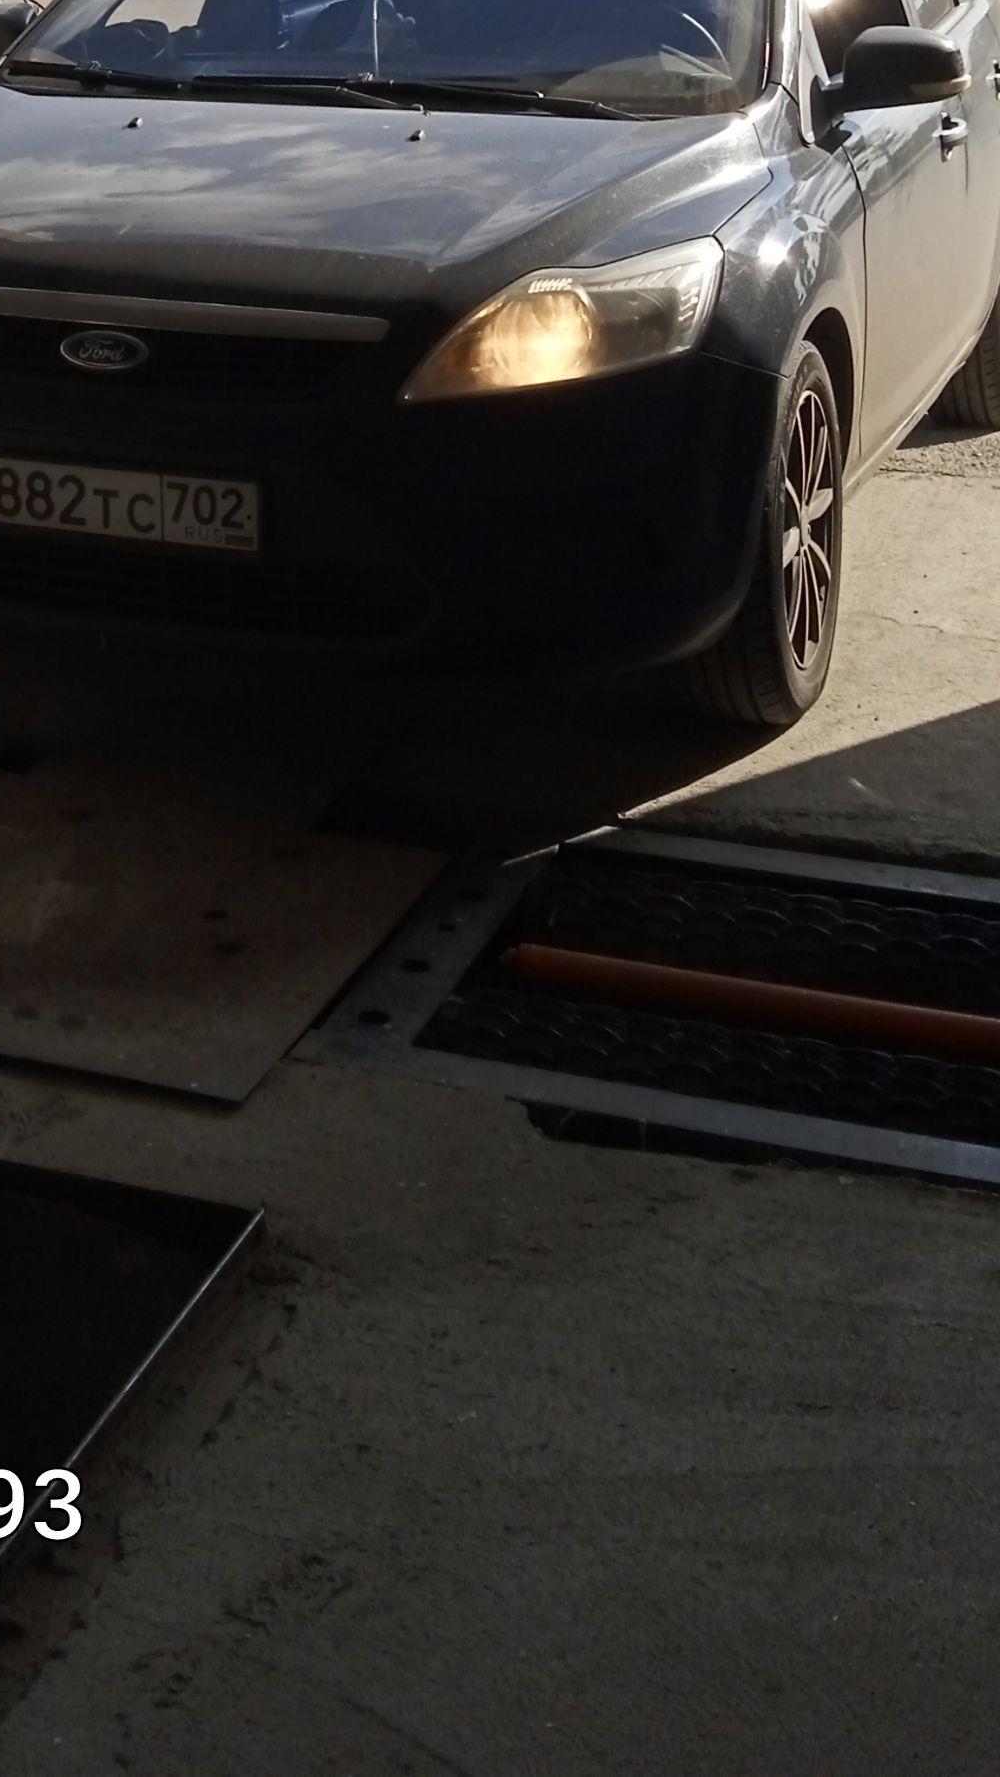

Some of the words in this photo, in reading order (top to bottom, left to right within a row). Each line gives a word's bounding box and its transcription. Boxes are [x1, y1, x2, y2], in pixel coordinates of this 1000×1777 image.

[79, 338, 127, 361] Ford
[166, 481, 245, 529] 702
[184, 525, 225, 543] RUS
